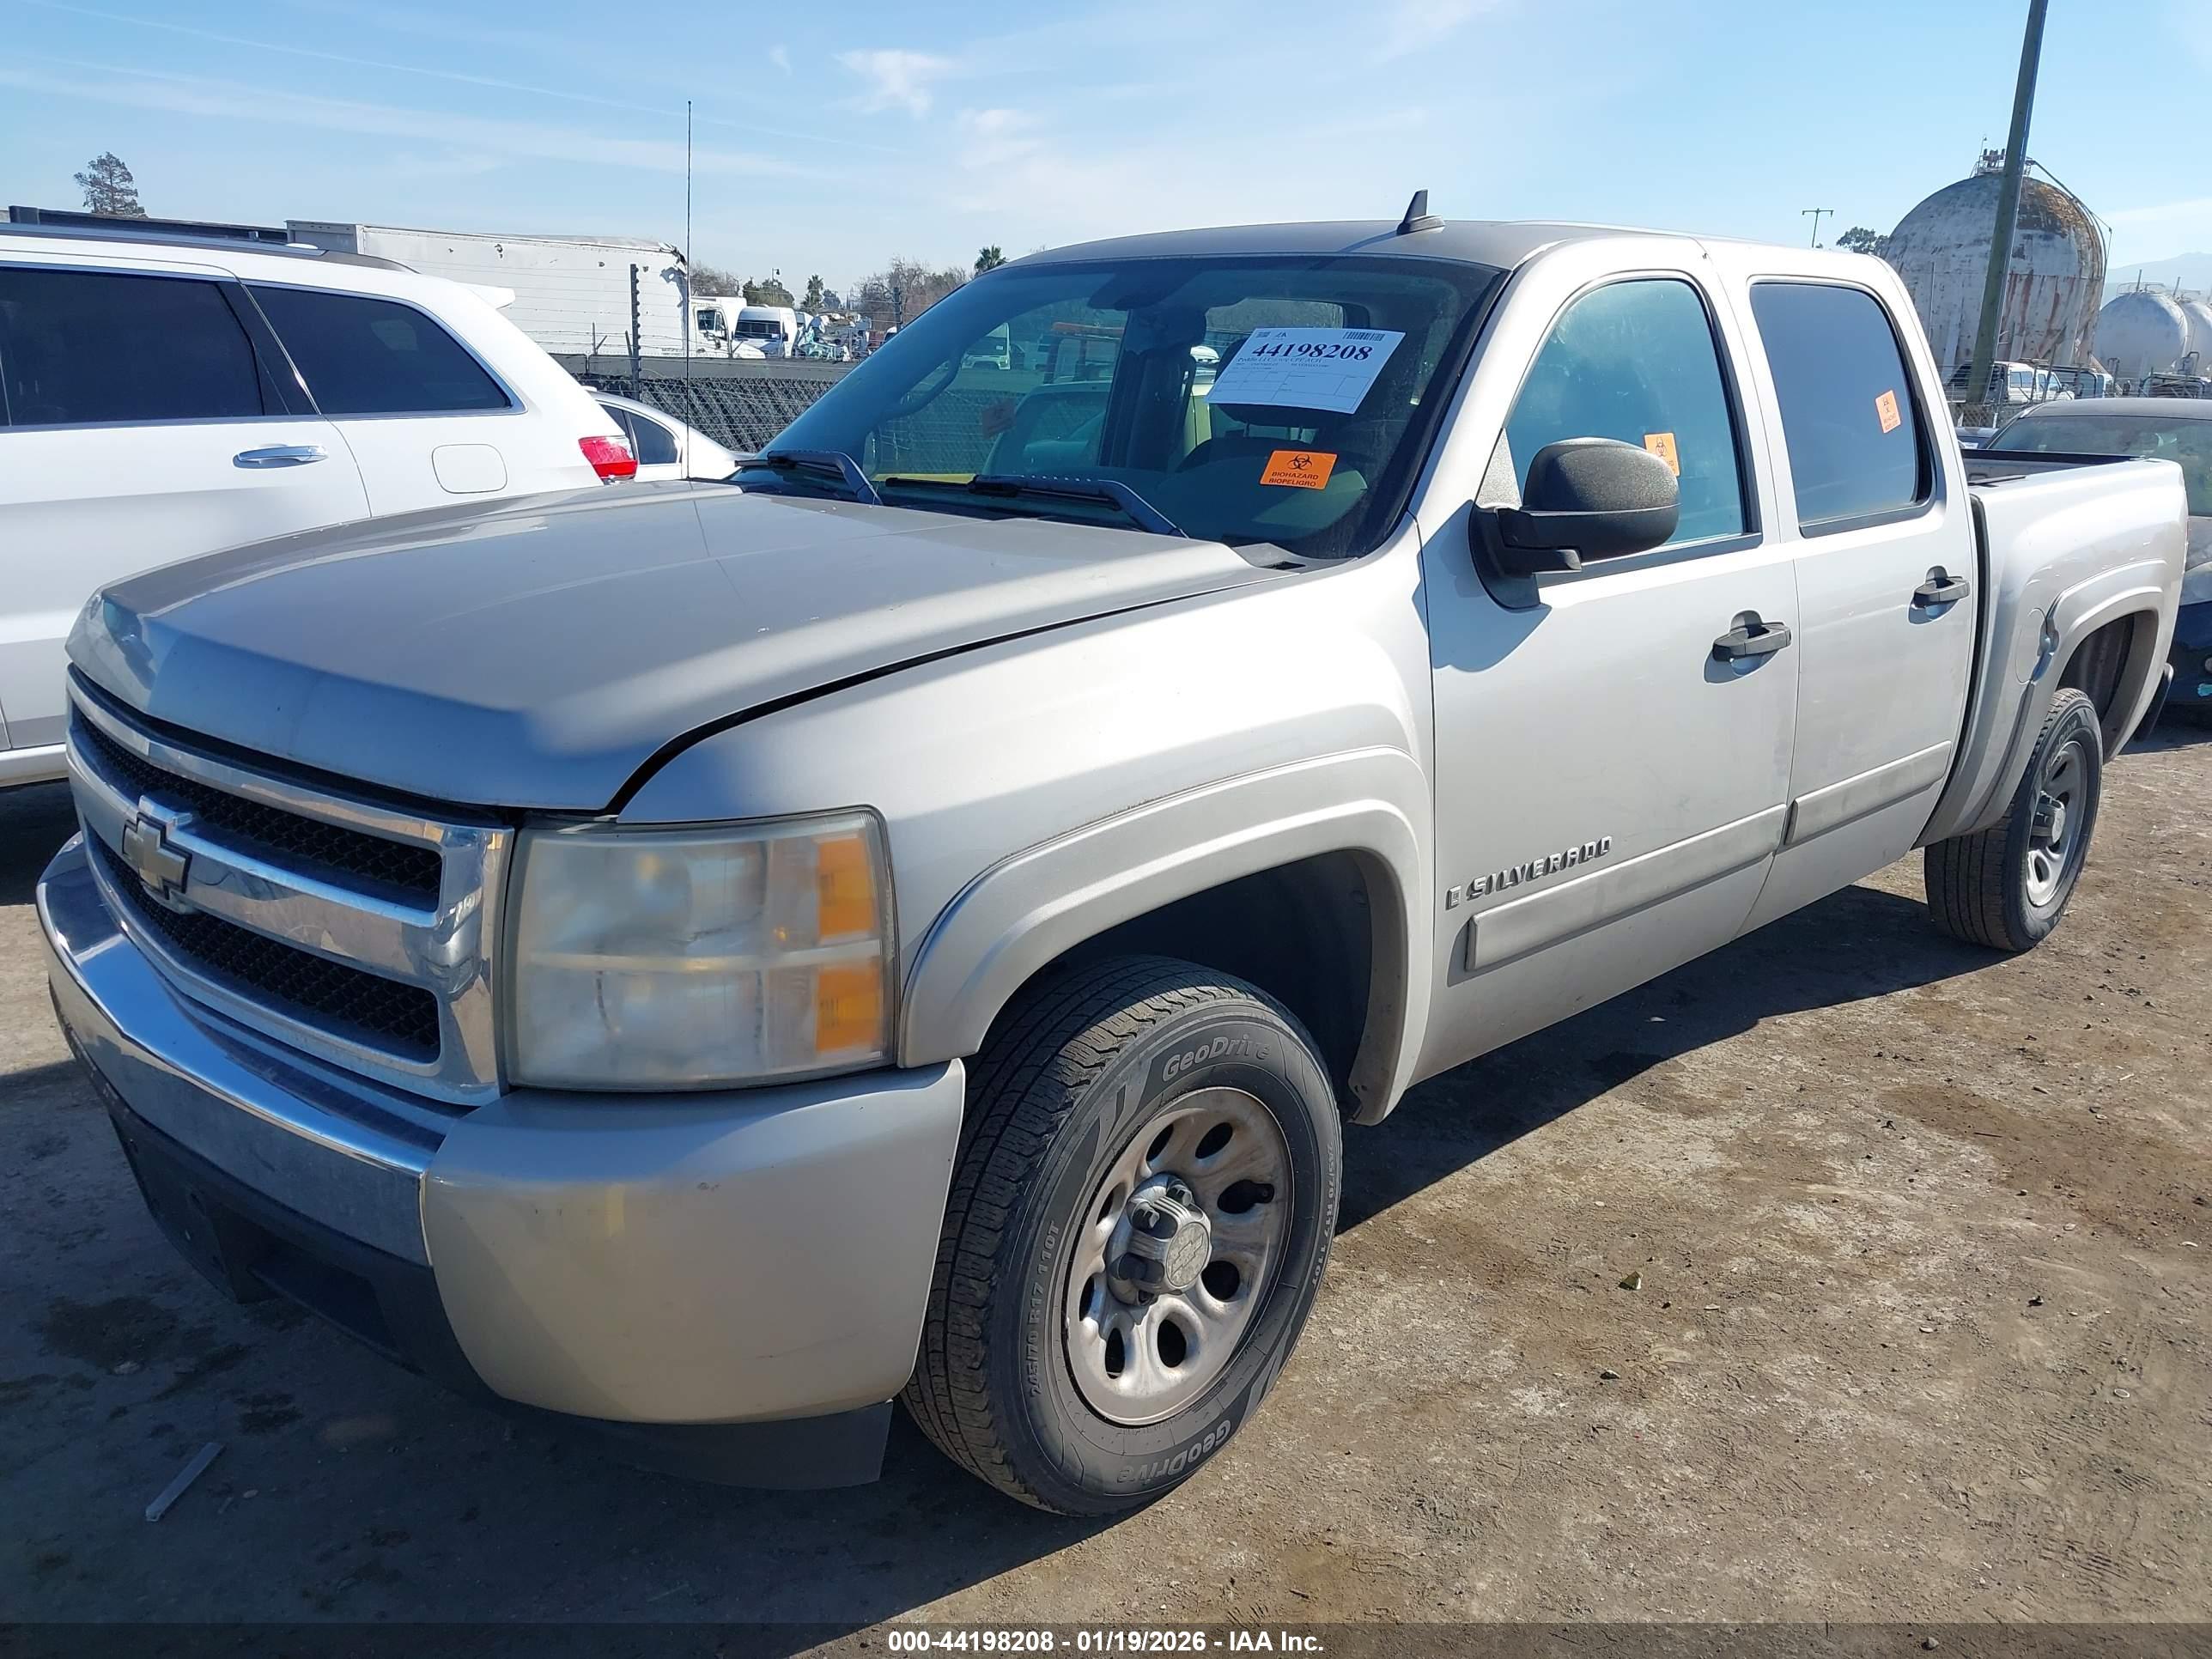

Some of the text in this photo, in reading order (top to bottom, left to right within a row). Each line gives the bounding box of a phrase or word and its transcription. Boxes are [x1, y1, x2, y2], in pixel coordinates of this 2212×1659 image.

[1252, 343, 1373, 361] 44198208
[1269, 478, 1316, 487] BIOPELIGRO
[1272, 471, 1319, 480] BIOHAZARD
[1467, 836, 1613, 901] SILVERADO
[1162, 1033, 1271, 1082] GeoDrive
[1029, 1281, 1044, 1324] R17
[1037, 1220, 1060, 1275] 110T
[1116, 1419, 1231, 1486] GeoDrive
